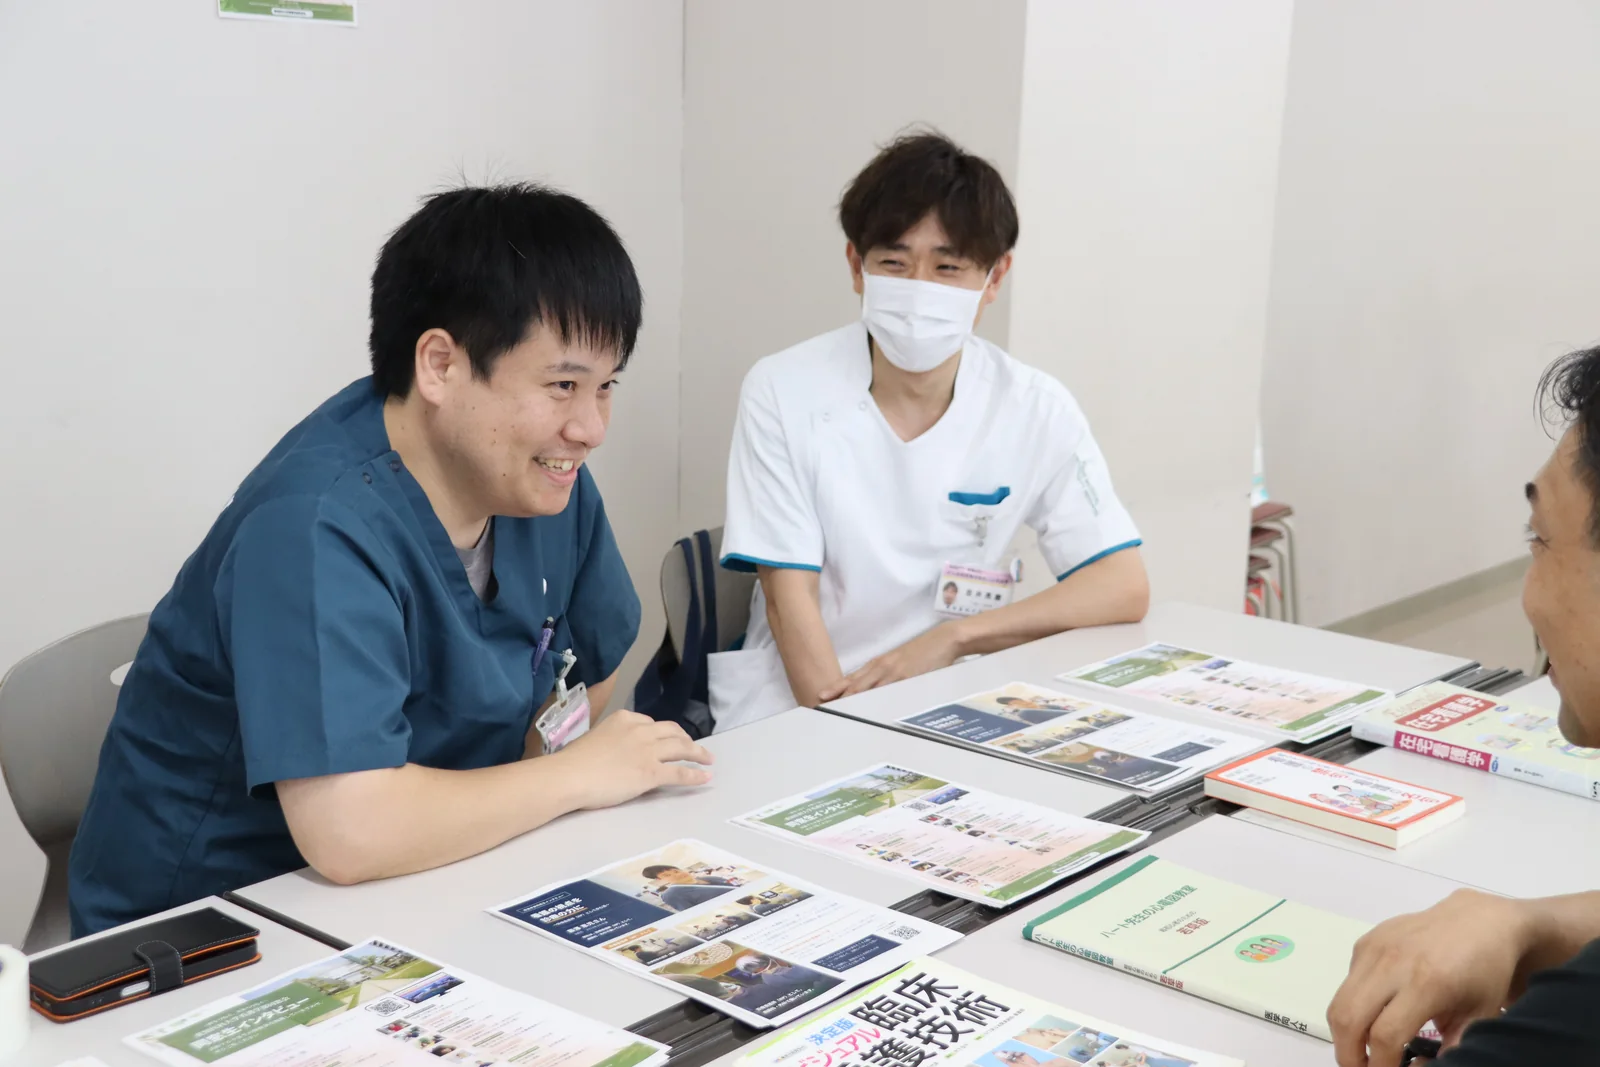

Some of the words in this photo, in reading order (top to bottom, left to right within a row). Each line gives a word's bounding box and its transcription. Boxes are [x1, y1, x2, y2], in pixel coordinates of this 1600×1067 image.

[1405, 696, 1485, 730] 在宅看護学
[1400, 735, 1485, 767] 在宅看護学
[1100, 884, 1198, 938] ハート先生の心電図教室
[1034, 933, 1114, 966] ハート先生の心電図教室
[848, 971, 959, 1031] 臨床
[807, 1017, 857, 1046] 決定版
[838, 990, 1011, 1067] 護技術
